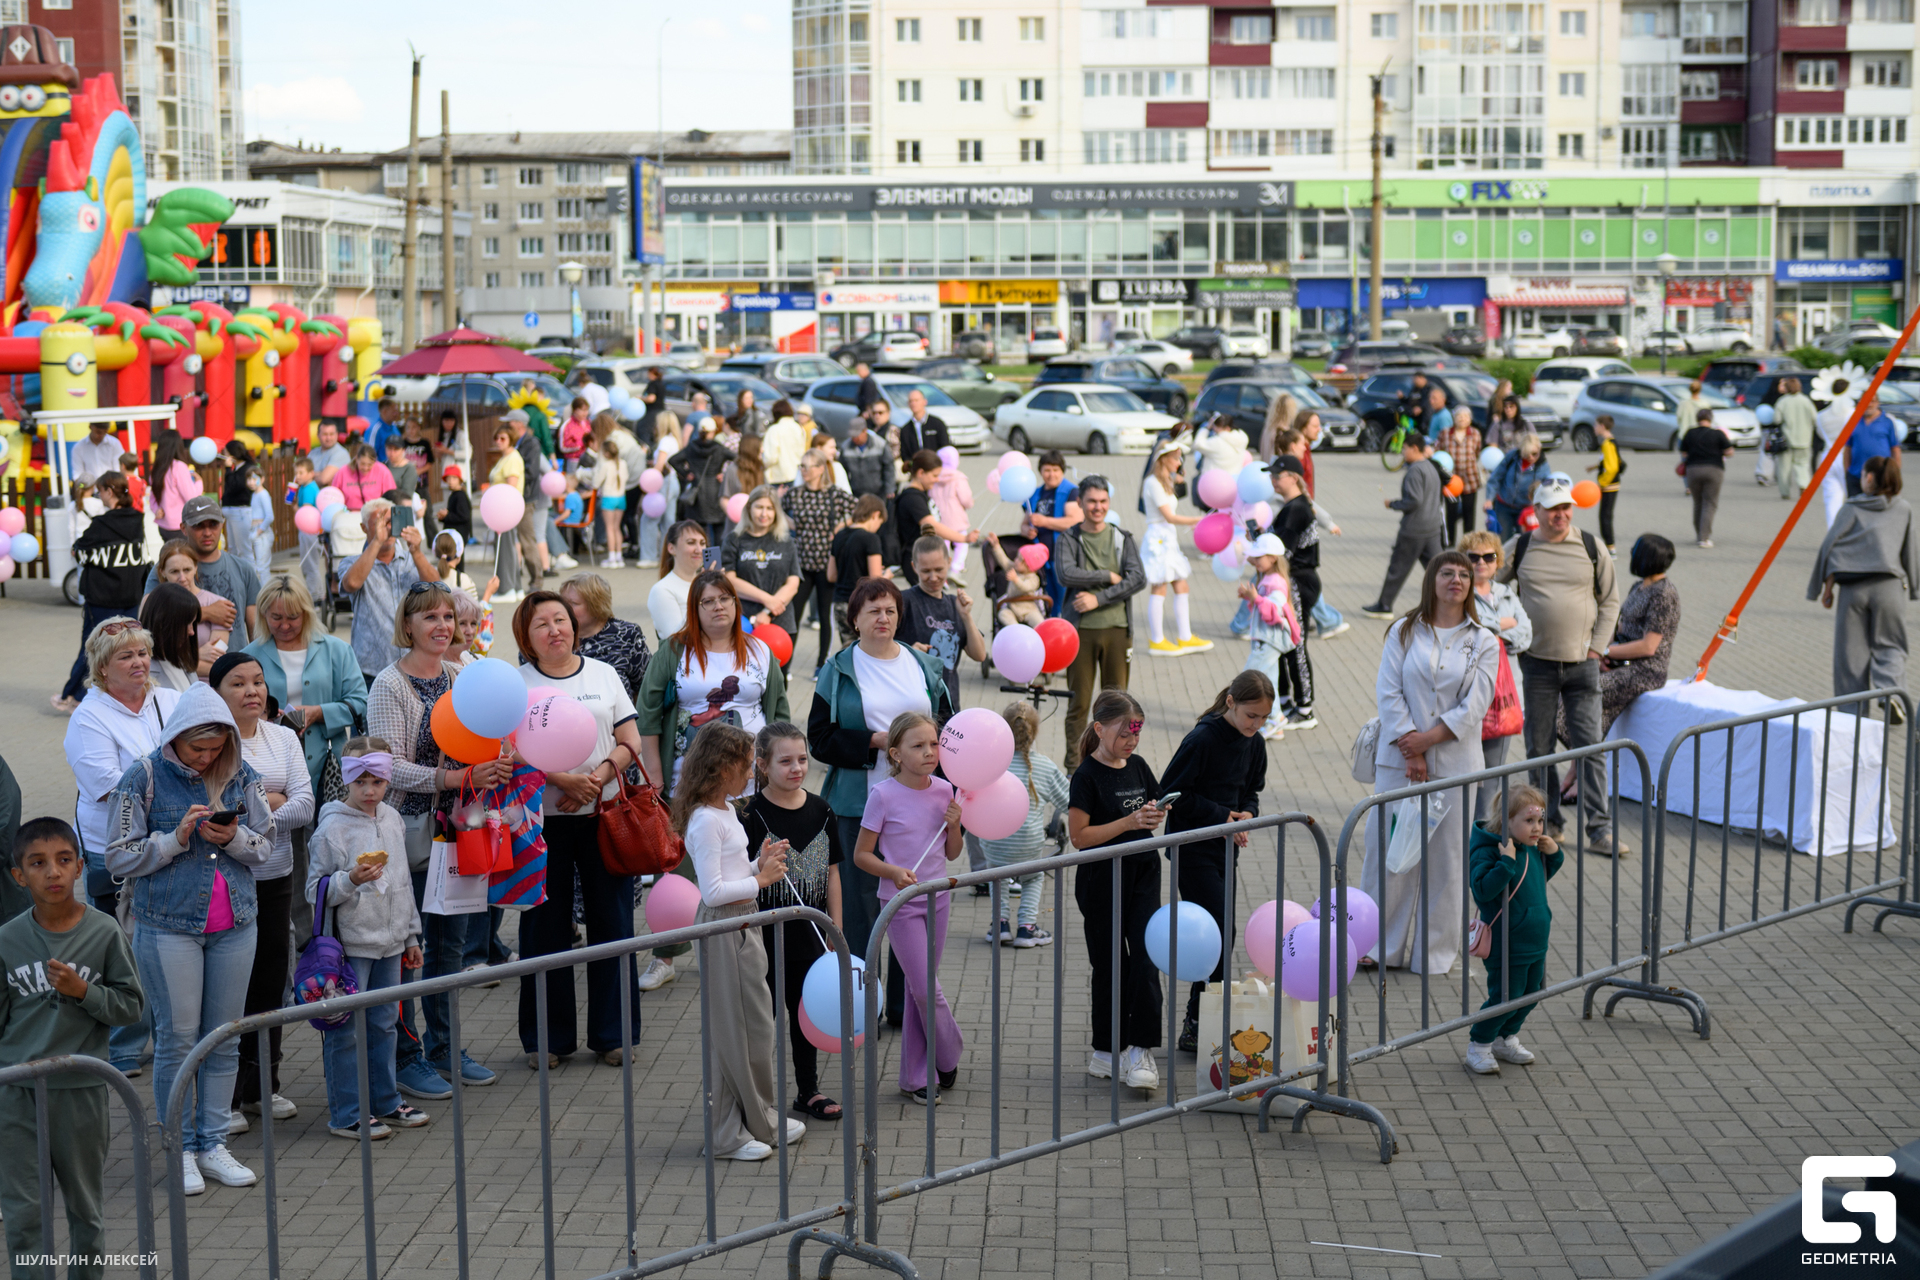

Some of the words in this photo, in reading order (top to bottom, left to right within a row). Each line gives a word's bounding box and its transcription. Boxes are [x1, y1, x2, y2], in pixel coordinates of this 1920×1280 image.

[875, 187, 968, 206] ЭЛЕМЕНТ
[970, 187, 1033, 207] МОДЫ
[1051, 188, 1118, 201] ОДЕЖДА
[1120, 189, 1132, 200] И
[1134, 188, 1240, 201] АКСЕССУАРЫ
[1472, 181, 1512, 200] FIX
[669, 193, 733, 205] ОДЕЖДА
[736, 193, 747, 203] И
[751, 192, 854, 204] АКСЕССУАРЫ
[1122, 280, 1188, 294] TURBA
